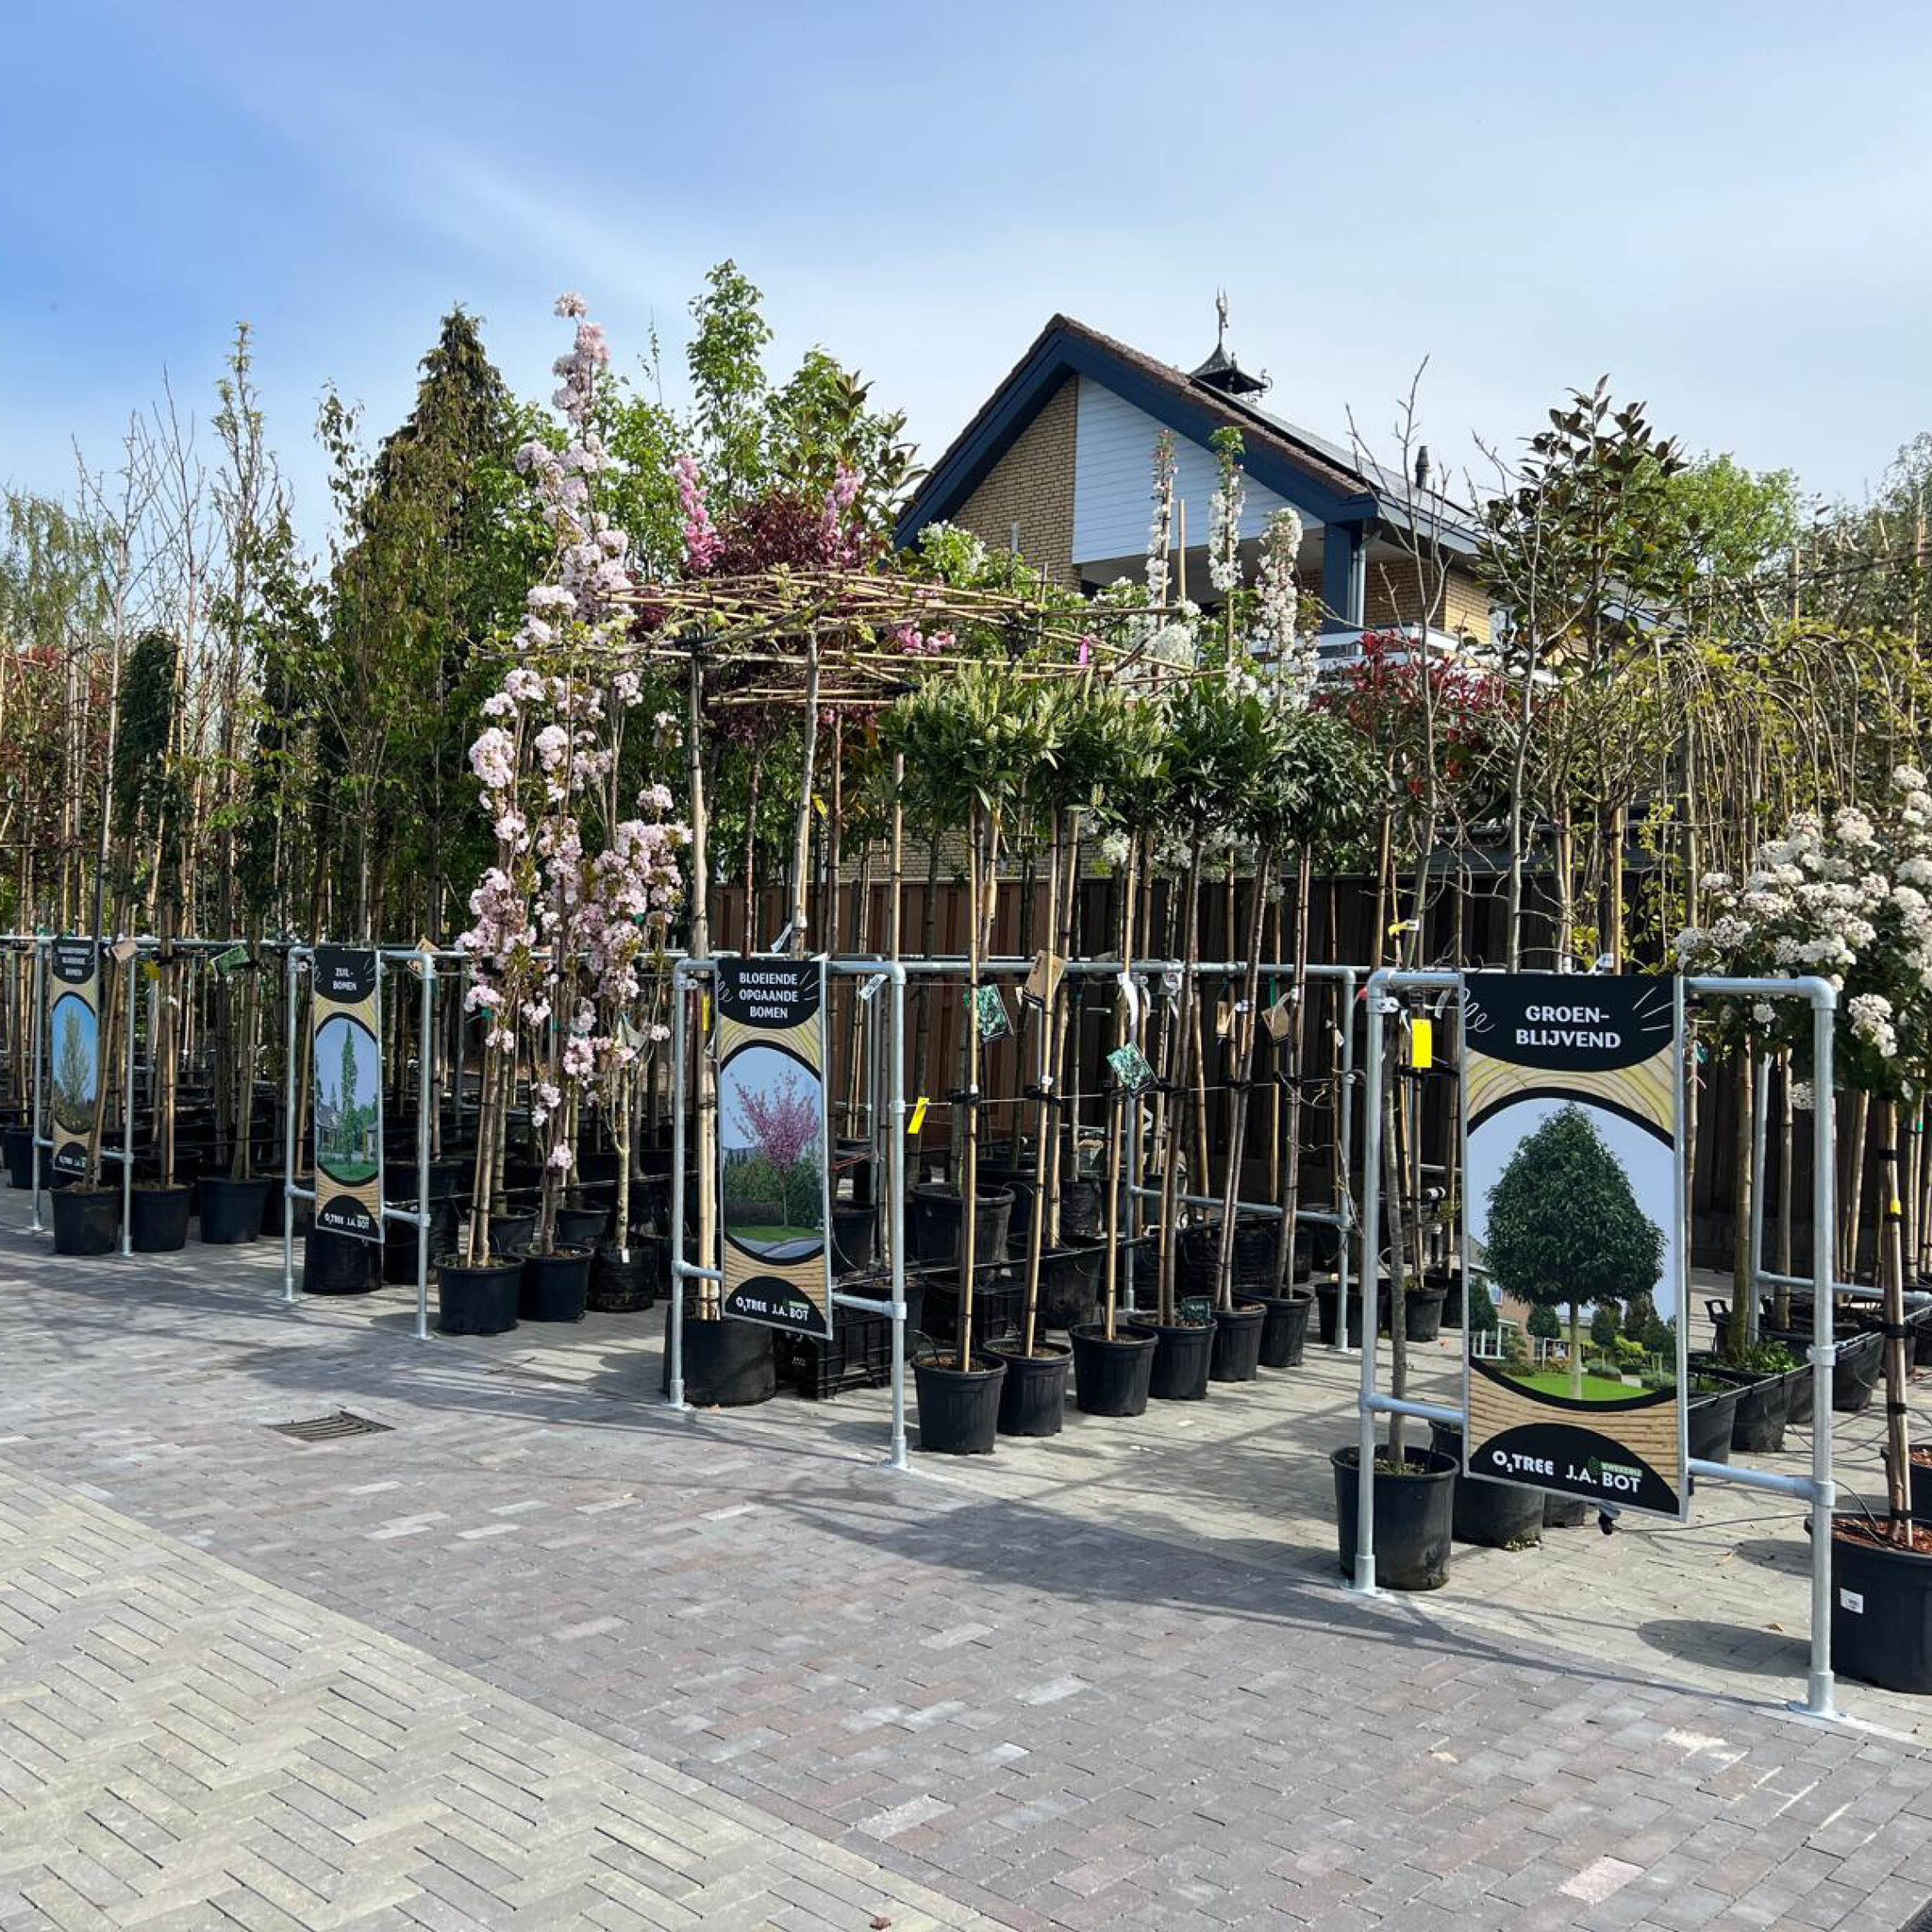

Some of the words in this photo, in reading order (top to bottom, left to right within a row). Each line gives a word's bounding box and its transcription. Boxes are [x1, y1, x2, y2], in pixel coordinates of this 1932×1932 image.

[739, 972, 798, 985] BLOEIENDE
[739, 989, 799, 1002] OPGAANDE
[749, 1006, 789, 1018] BOMEN
[1524, 1006, 1609, 1024] GROEN-
[1516, 1028, 1622, 1048] BLIJVEND
[790, 1307, 809, 1321] BOT
[1564, 1464, 1598, 1485] J.A.
[1602, 1471, 1641, 1493] BOT
